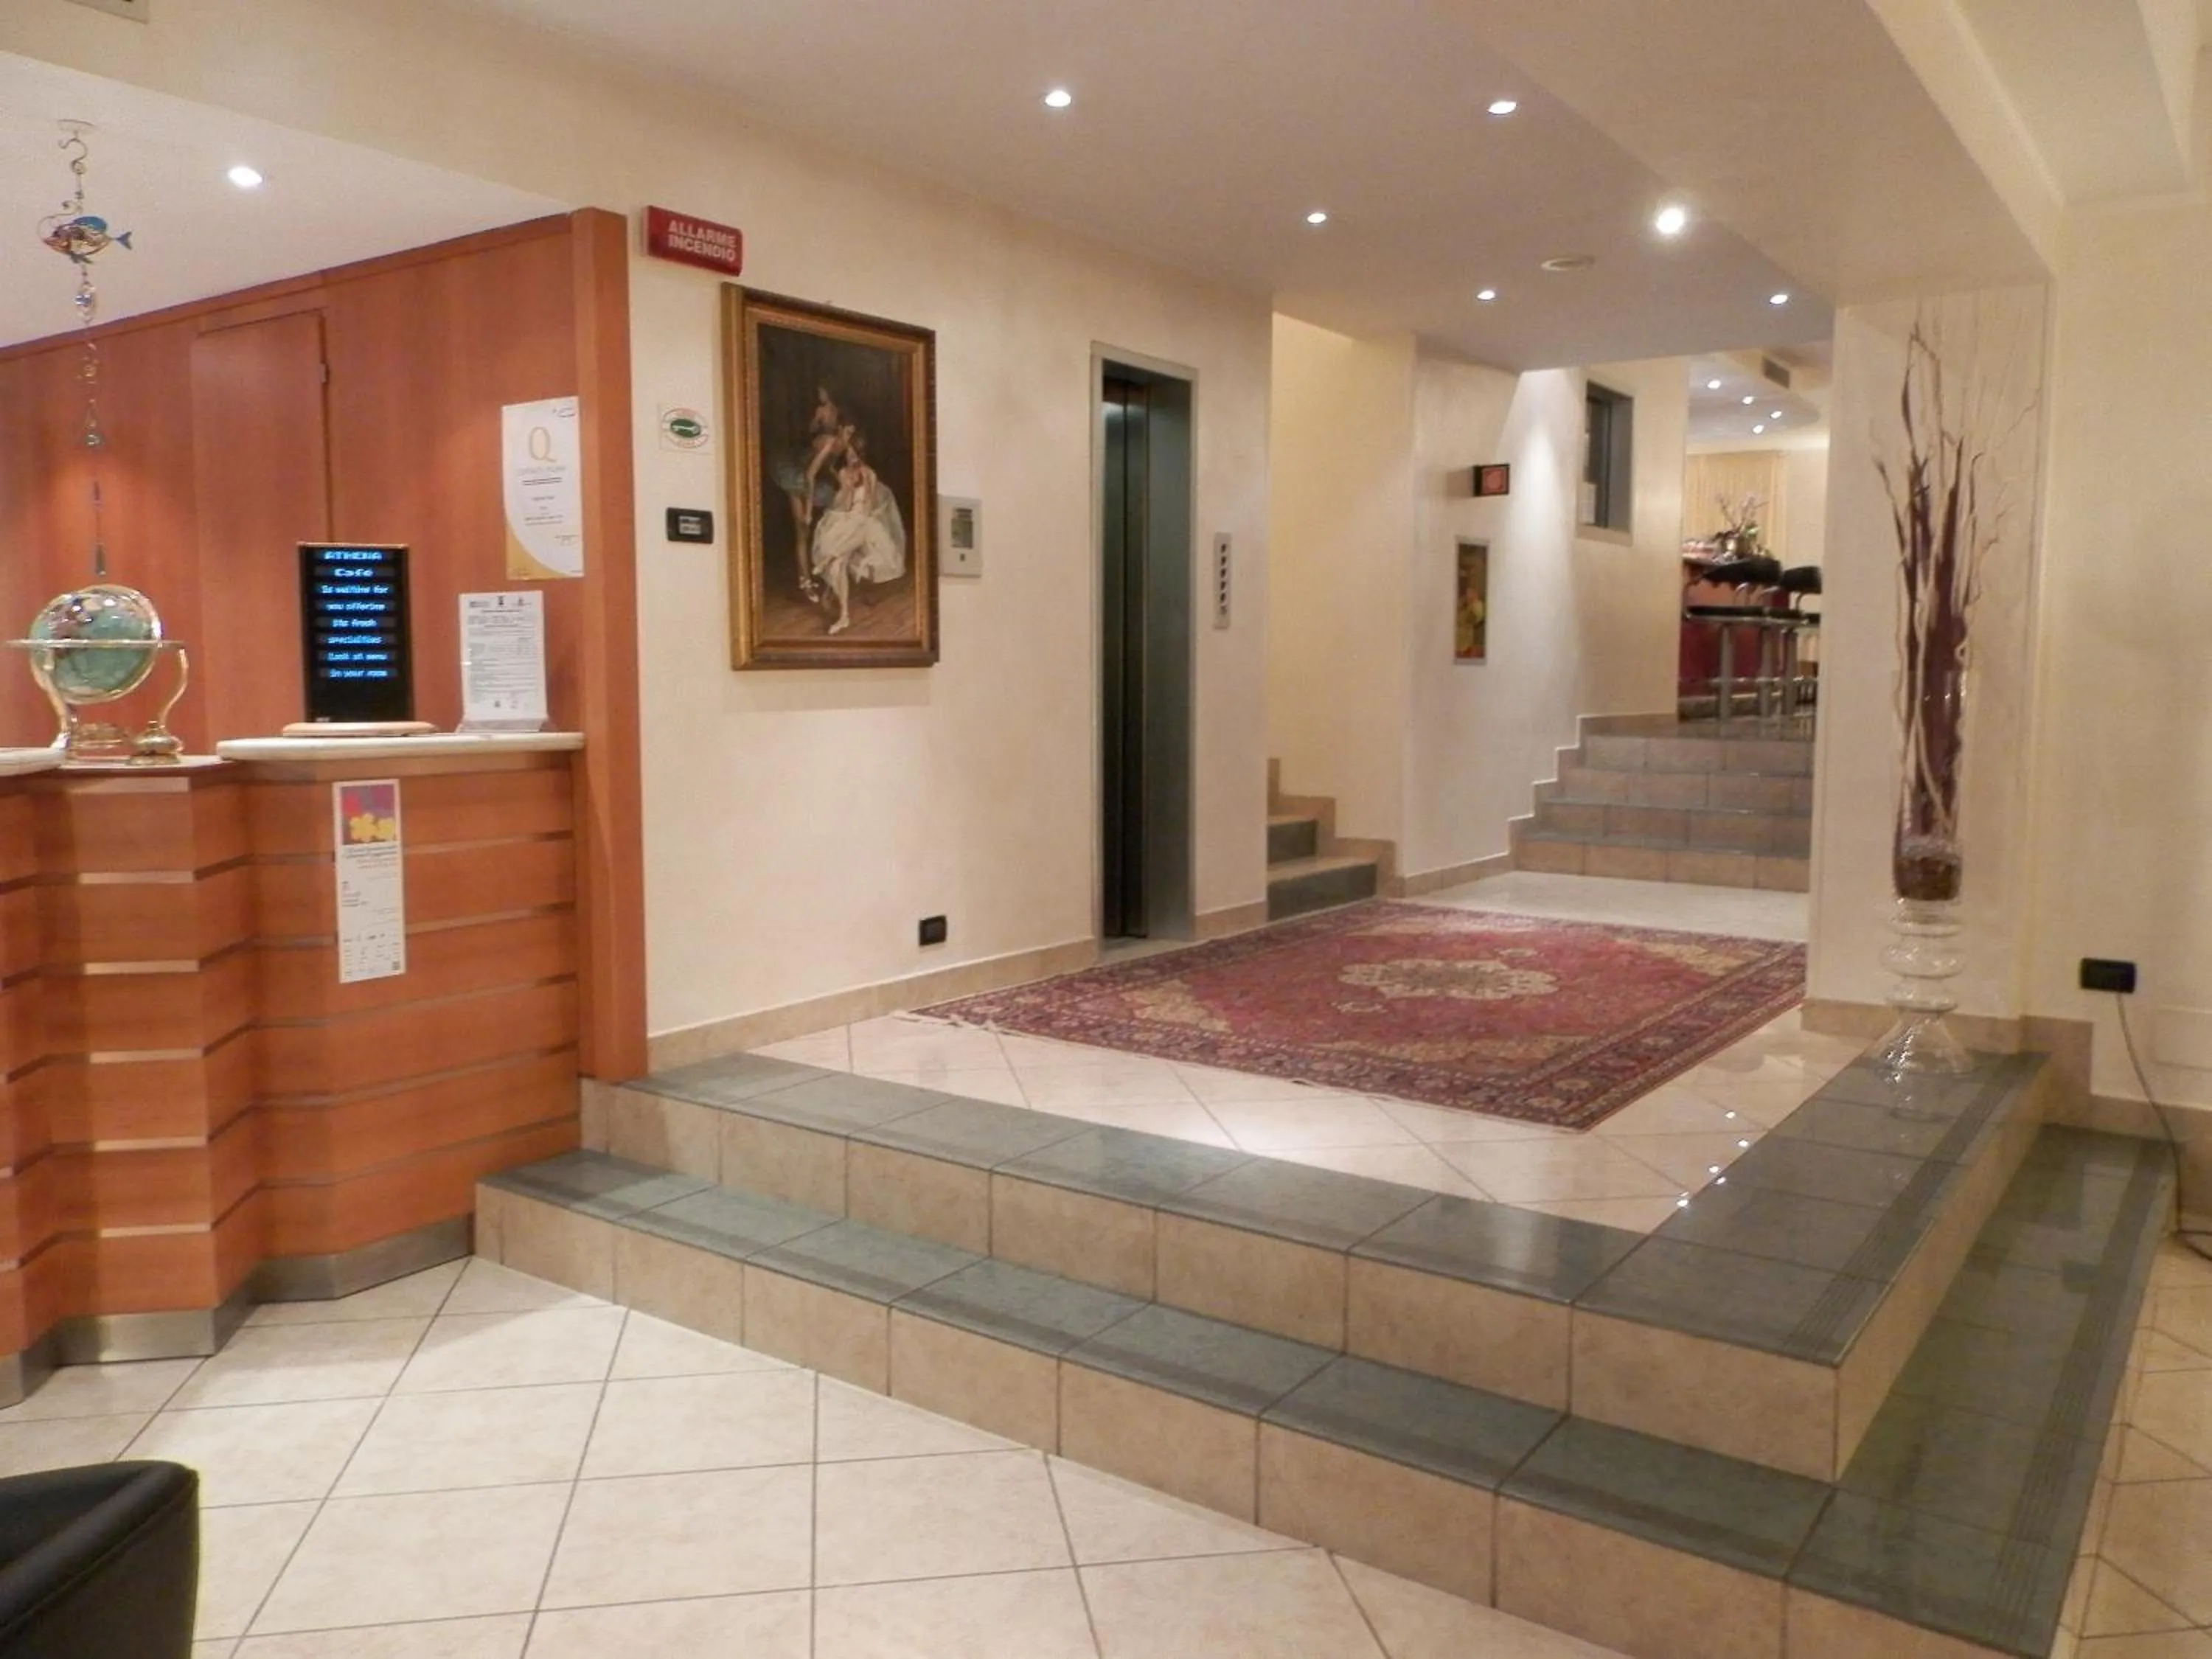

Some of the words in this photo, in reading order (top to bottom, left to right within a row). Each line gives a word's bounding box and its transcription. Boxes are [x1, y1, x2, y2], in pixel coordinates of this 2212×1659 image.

[668, 220, 737, 248] ALLARME
[668, 234, 737, 262] INCENDIO
[529, 426, 557, 462] Q
[324, 551, 383, 560] ATHENA
